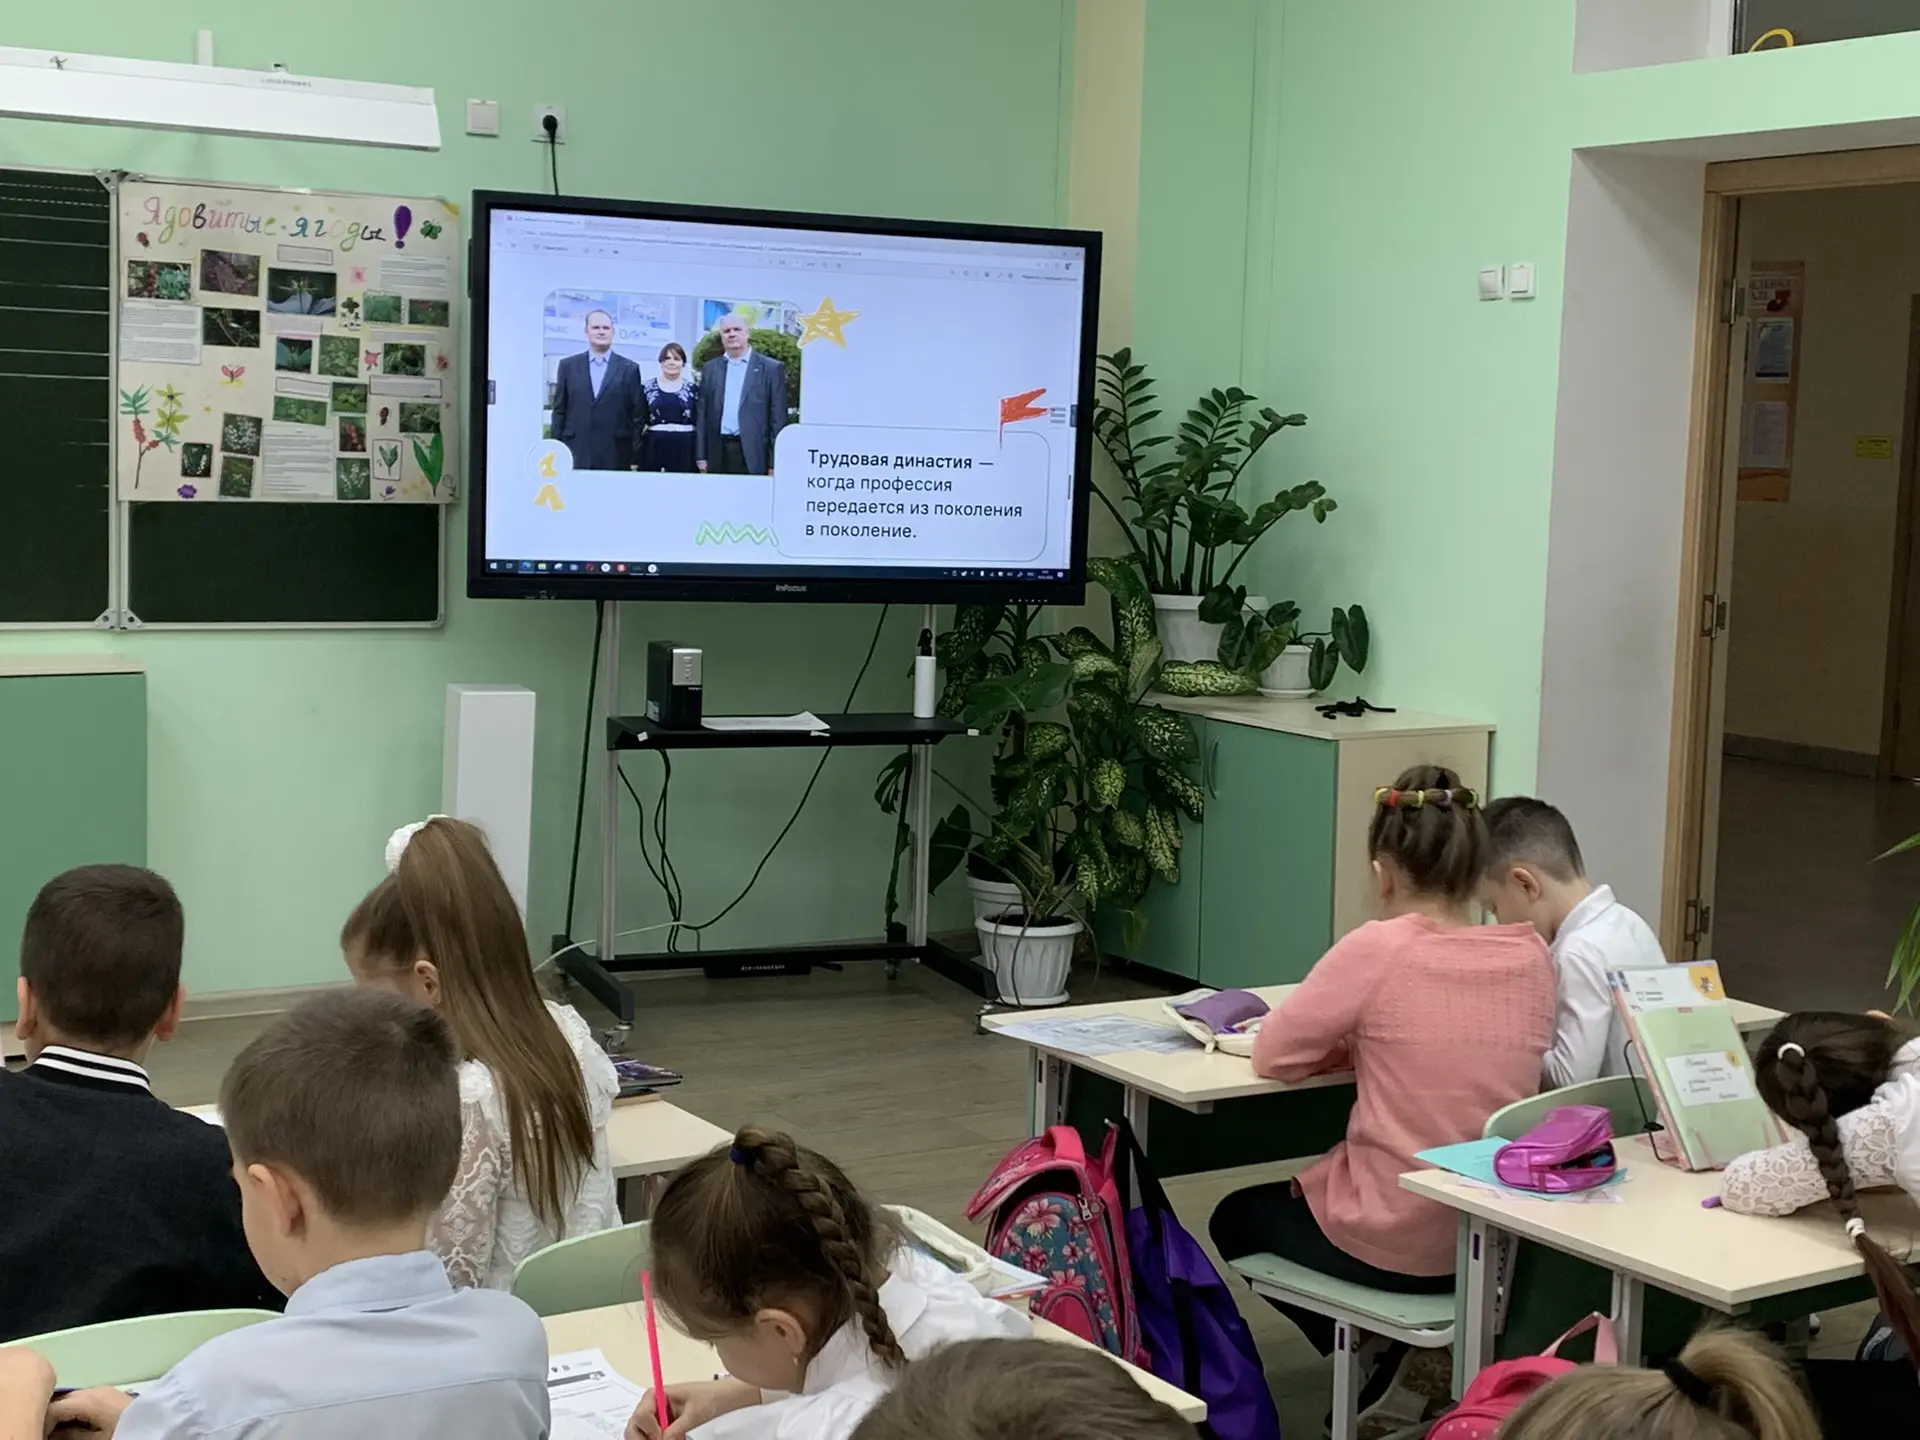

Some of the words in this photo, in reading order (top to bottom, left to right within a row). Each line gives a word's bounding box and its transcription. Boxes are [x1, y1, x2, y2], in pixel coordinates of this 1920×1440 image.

[143, 197, 276, 244] Ядовитые
[808, 449, 888, 468] Трудовая
[893, 454, 973, 469] династия
[807, 476, 855, 491] когда
[860, 476, 952, 494] профессия
[806, 500, 904, 516] передается
[909, 502, 929, 515] из
[934, 503, 1023, 517] поколения
[805, 524, 815, 536] в
[820, 524, 917, 538] поколение.
